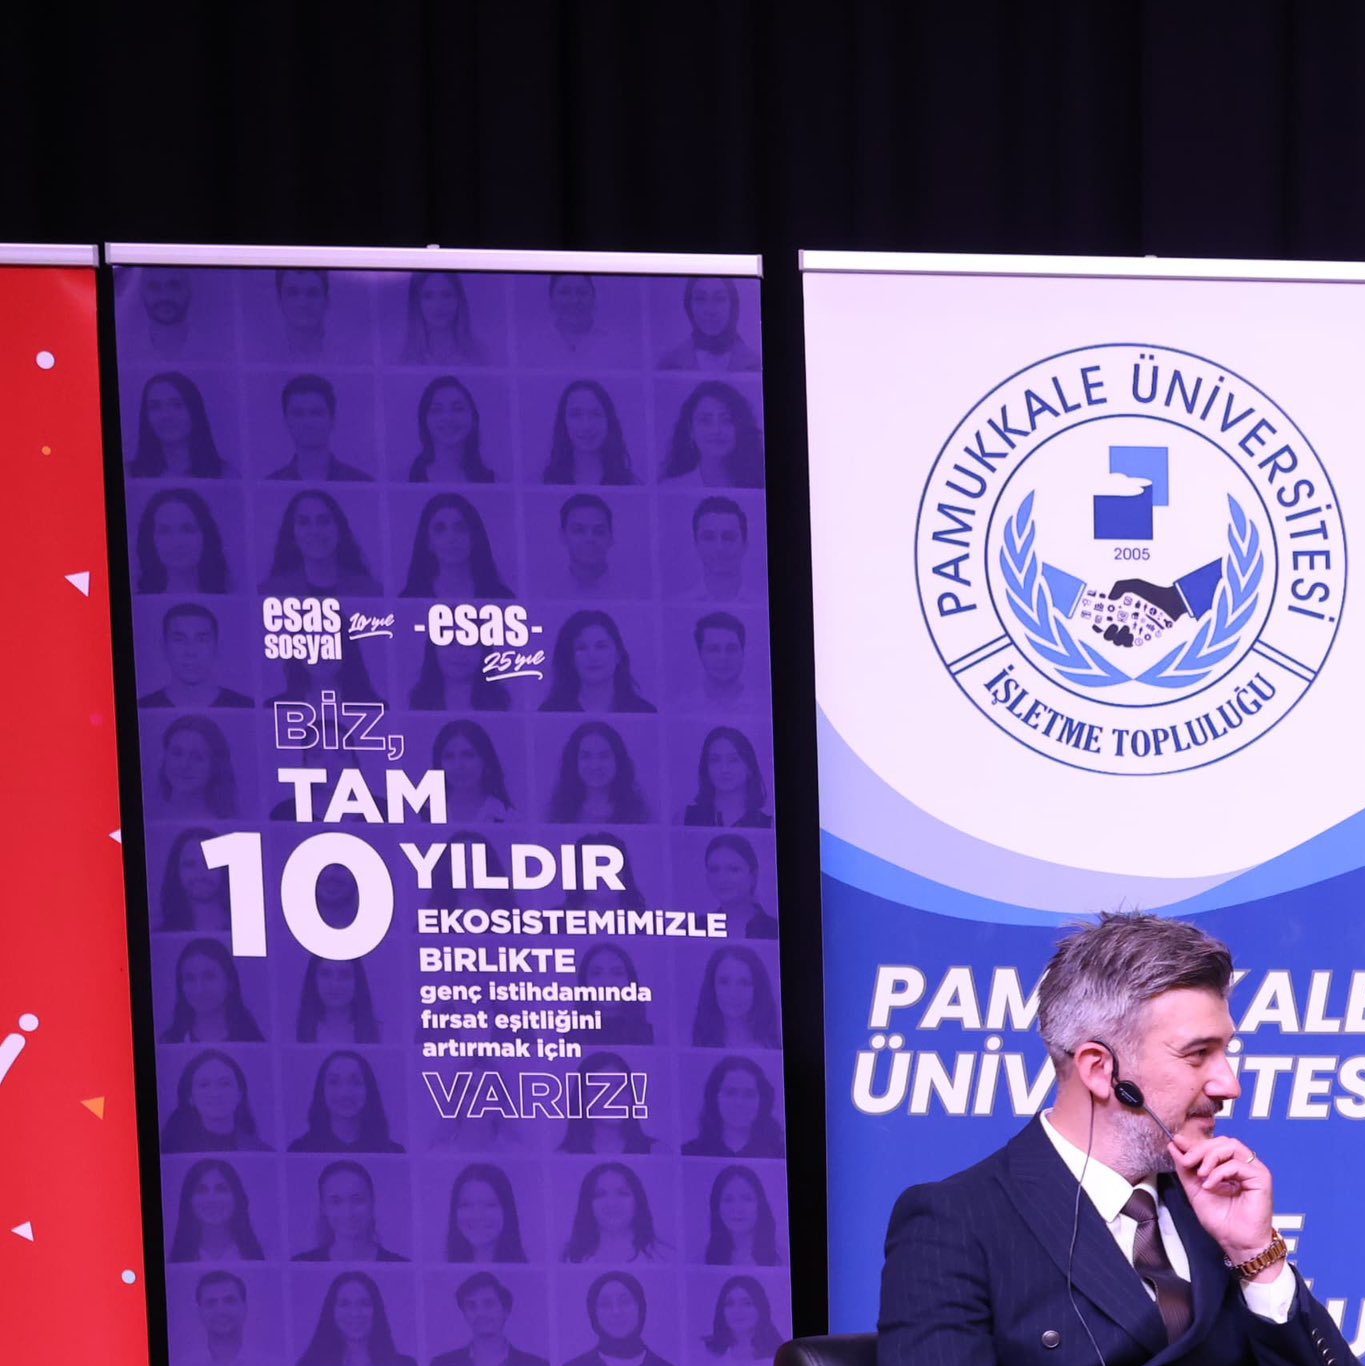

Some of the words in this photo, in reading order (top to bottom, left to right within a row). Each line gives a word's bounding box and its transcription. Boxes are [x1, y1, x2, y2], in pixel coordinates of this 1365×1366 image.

[932, 365, 1108, 617] PAMUKKALE
[1132, 353, 1335, 623] ÜNİVERSİTESİ
[1113, 547, 1151, 561] 2005
[262, 597, 341, 632] esas
[264, 633, 342, 664] sosyal
[482, 651, 512, 674] 25
[273, 690, 405, 760] BİZ,
[983, 664, 1103, 754] İŞLETME
[1112, 672, 1277, 757] TOPLULUĞU
[277, 768, 447, 823] TAM
[200, 832, 395, 961] 10
[400, 842, 625, 890] YILDIR
[420, 981, 482, 1006] genç
[488, 981, 652, 1004] istihdamında
[421, 1009, 487, 1030] fırsat
[494, 1009, 602, 1035] eşitliğini
[422, 1037, 532, 1058] artırmak
[537, 1037, 582, 1063] için
[422, 1072, 648, 1118] VARIZ!
